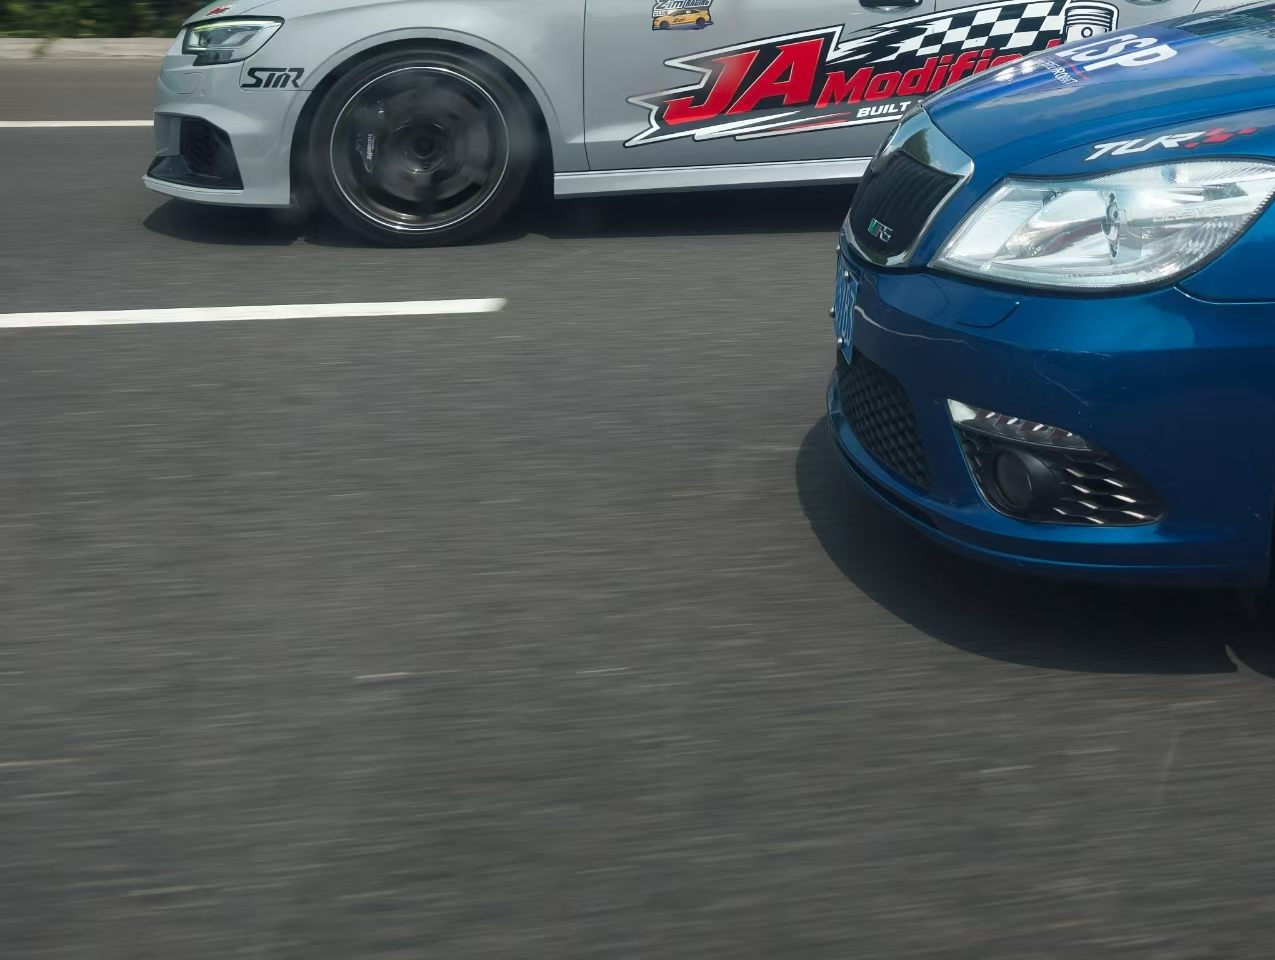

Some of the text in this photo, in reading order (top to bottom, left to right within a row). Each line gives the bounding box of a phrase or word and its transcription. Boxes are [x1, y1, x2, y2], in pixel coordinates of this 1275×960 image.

[663, 37, 1062, 126] JA Modifi
[856, 99, 911, 118] BUILT
